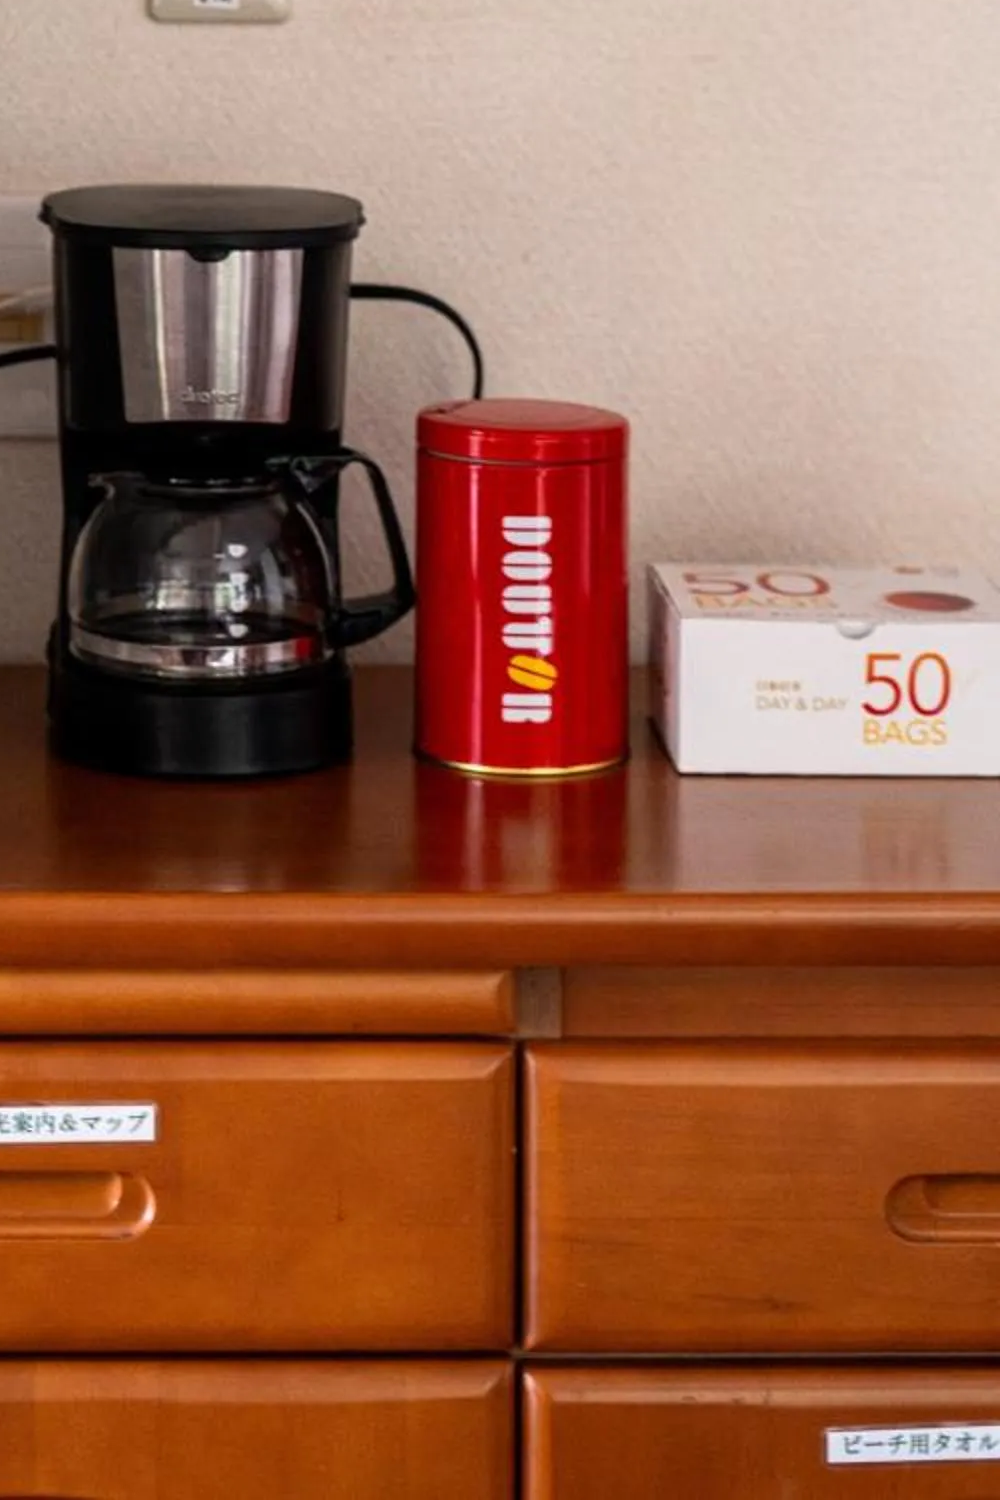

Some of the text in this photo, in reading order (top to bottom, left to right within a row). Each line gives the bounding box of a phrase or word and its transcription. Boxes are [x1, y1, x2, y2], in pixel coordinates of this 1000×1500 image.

[682, 566, 830, 598] 50
[502, 515, 558, 723] DOUTOR
[862, 652, 952, 716] 50
[862, 719, 948, 745] BAGS
[843, 1432, 1000, 1455] ビーチ用タオル
